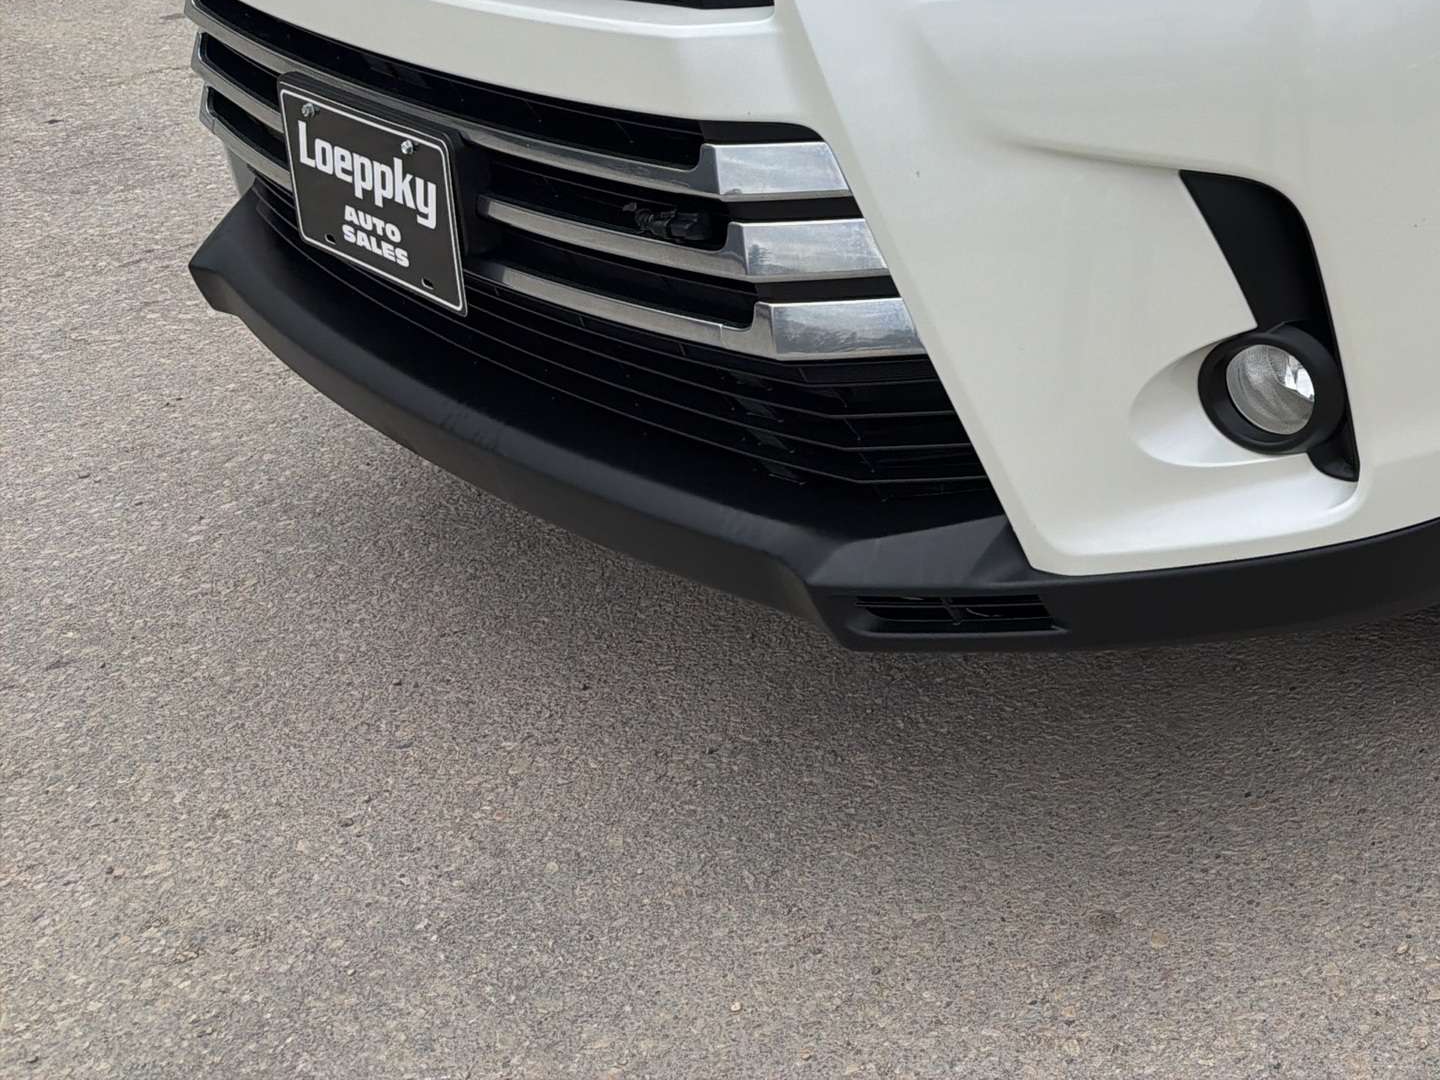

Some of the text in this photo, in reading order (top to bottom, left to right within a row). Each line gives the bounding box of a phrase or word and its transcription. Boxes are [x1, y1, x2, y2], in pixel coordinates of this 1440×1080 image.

[298, 120, 436, 230] Loeppky
[342, 224, 409, 268] SALES
[344, 205, 401, 243] AUTO
